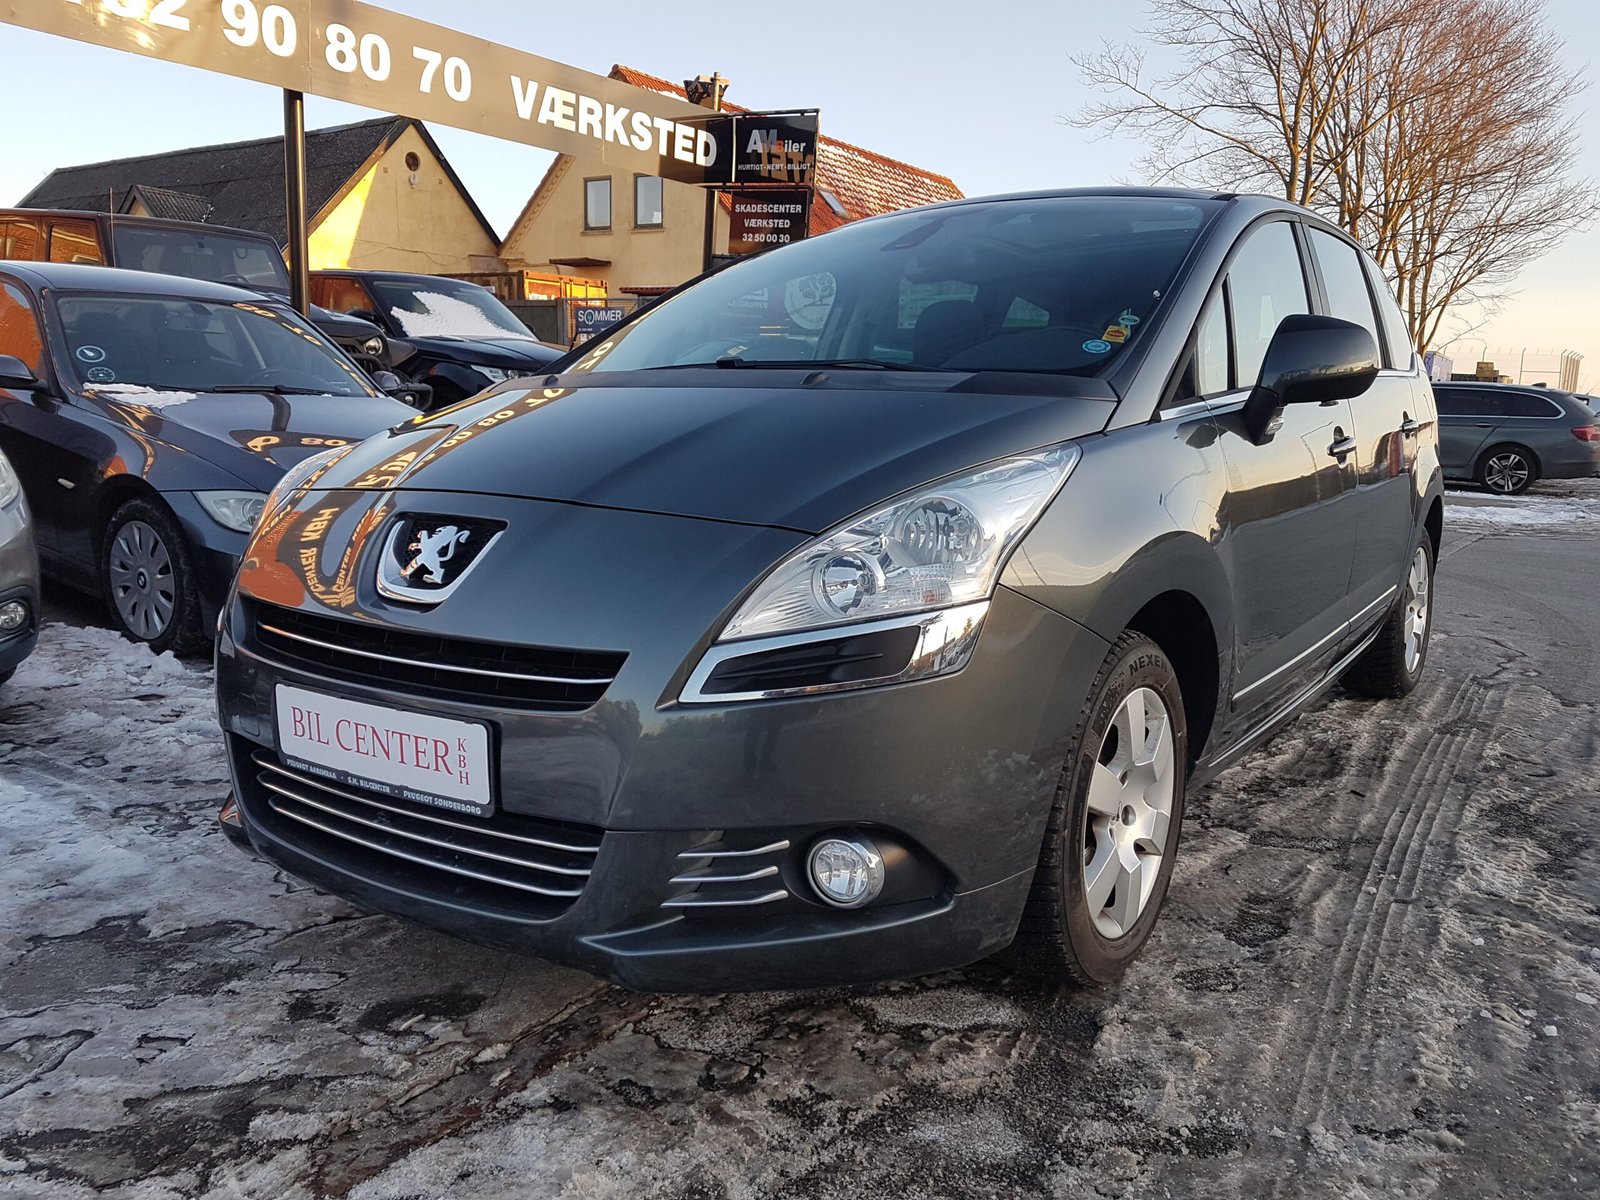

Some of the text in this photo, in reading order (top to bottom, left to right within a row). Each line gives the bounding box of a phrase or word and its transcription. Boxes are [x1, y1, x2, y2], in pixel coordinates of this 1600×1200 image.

[221, 0, 297, 57] 90
[325, 23, 391, 81] 80
[412, 46, 472, 102] 70
[510, 75, 717, 167] VÆRKSTED
[787, 163, 811, 171] BILLIGT
[735, 204, 802, 213] SKADESCENTER
[744, 218, 791, 228] VÆRKSTED
[1129, 654, 1167, 676] NEXEN
[291, 706, 453, 775] BIL CENTER
[403, 790, 433, 804] PEUGEOT
